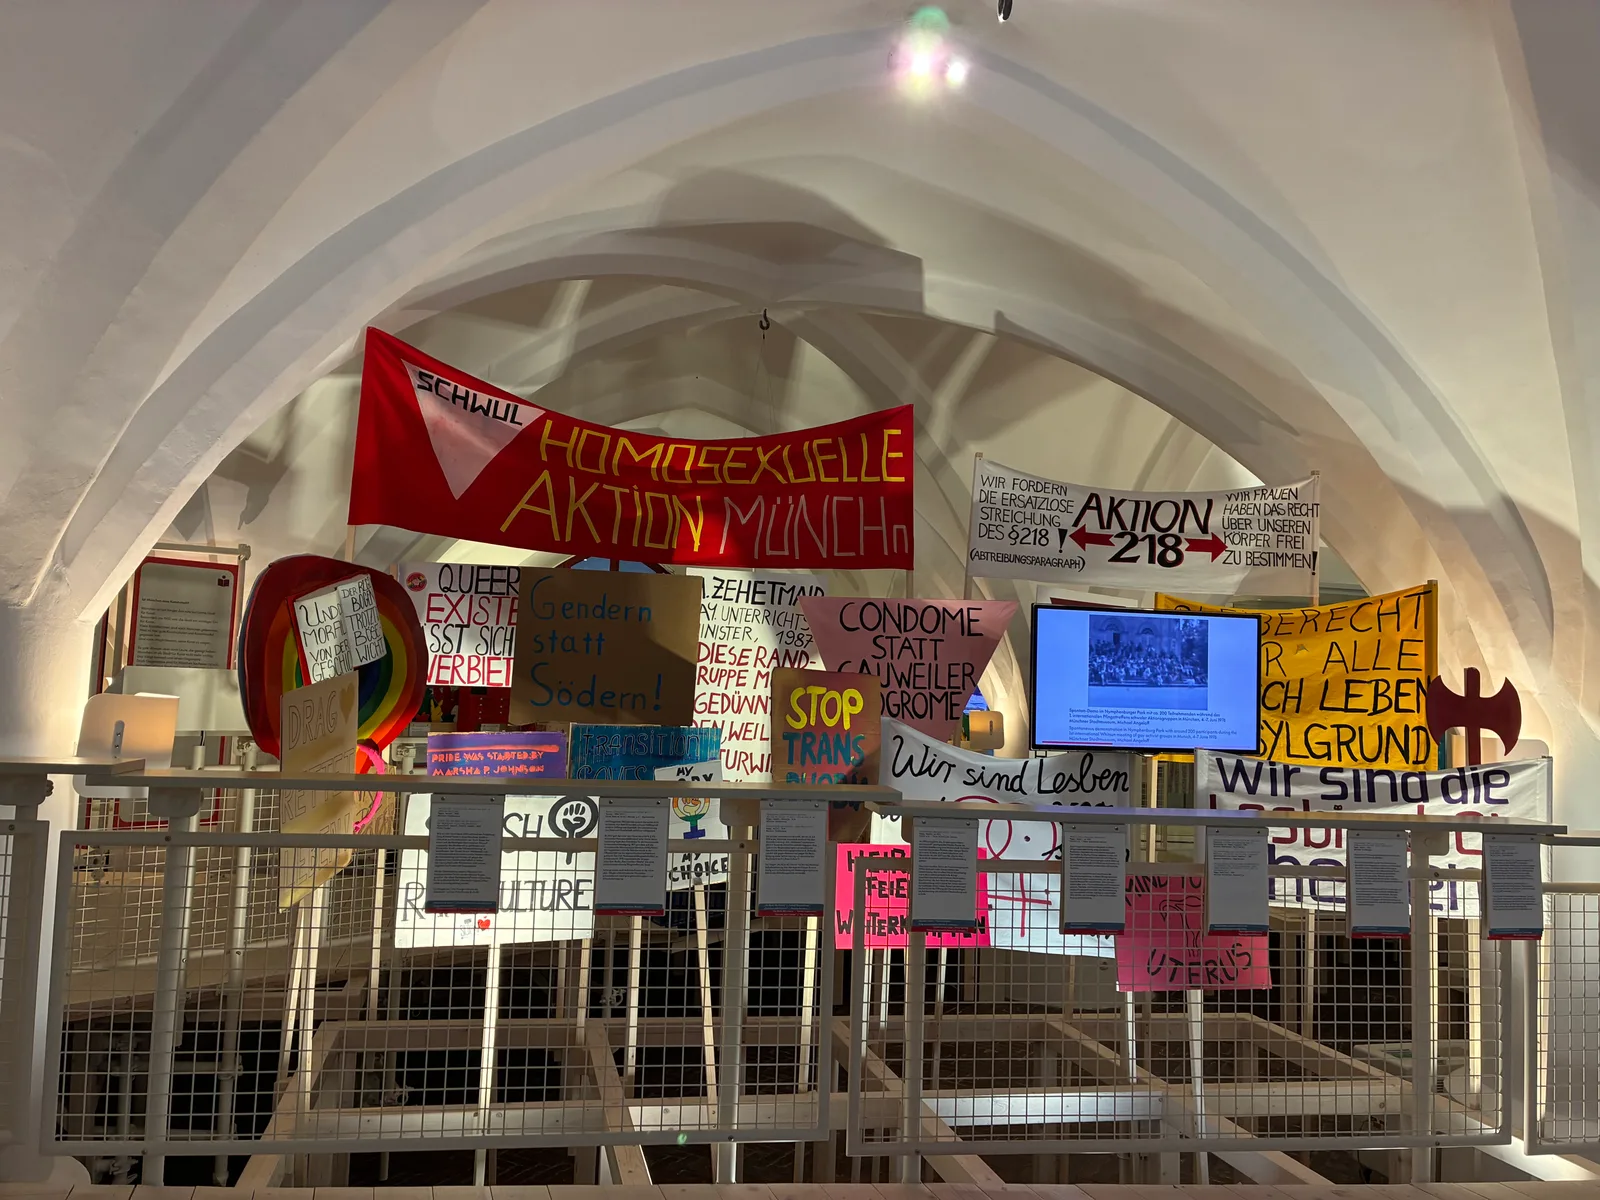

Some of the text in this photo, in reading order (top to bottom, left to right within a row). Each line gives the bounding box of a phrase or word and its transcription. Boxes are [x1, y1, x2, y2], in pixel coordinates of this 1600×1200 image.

[416, 370, 524, 427] SCHWUL
[540, 418, 906, 484] HOMOSEXUELLE
[980, 474, 1068, 497] WIR FORDERN
[1225, 487, 1298, 502] WIR FRAUEN
[978, 490, 1075, 514] DIE ERSATZLOSE
[1072, 492, 1214, 535] AKTION
[1223, 502, 1320, 518] HABEN DAS RECHT
[980, 506, 1061, 528] STREICHUNG
[1222, 515, 1311, 535] ÜBER UNSEREN
[978, 523, 1004, 541] DES
[1224, 531, 1305, 550] KÖRPER FREI
[969, 547, 1086, 573] (ABTREIBUNGSPARAGRAPH)
[1107, 531, 1183, 569] 218
[1222, 550, 1243, 566] ZU
[530, 575, 652, 622] Gendern
[839, 601, 984, 637] CONDOME
[475, 625, 515, 656] SICH
[533, 630, 606, 656] statt
[775, 630, 814, 649] 1987
[871, 634, 945, 660] STATT
[697, 641, 752, 667] DIESE
[1322, 638, 1424, 675] ALLE
[530, 661, 663, 712] Södern!
[1319, 675, 1431, 716] LEBEN
[288, 690, 338, 750] DRAG
[785, 685, 864, 731] STOP
[431, 752, 460, 763] PRIDE
[464, 752, 485, 762] WAS
[782, 731, 866, 768] TRANS
[432, 766, 480, 777] MARSHA
[493, 764, 545, 776] JOHNSON
[891, 734, 1129, 795] Wir sind Lesben
[1215, 757, 1301, 798] Wir
[1440, 766, 1511, 806] die
[668, 856, 729, 882] CHOICE
[1147, 943, 1252, 988] UTERUS
